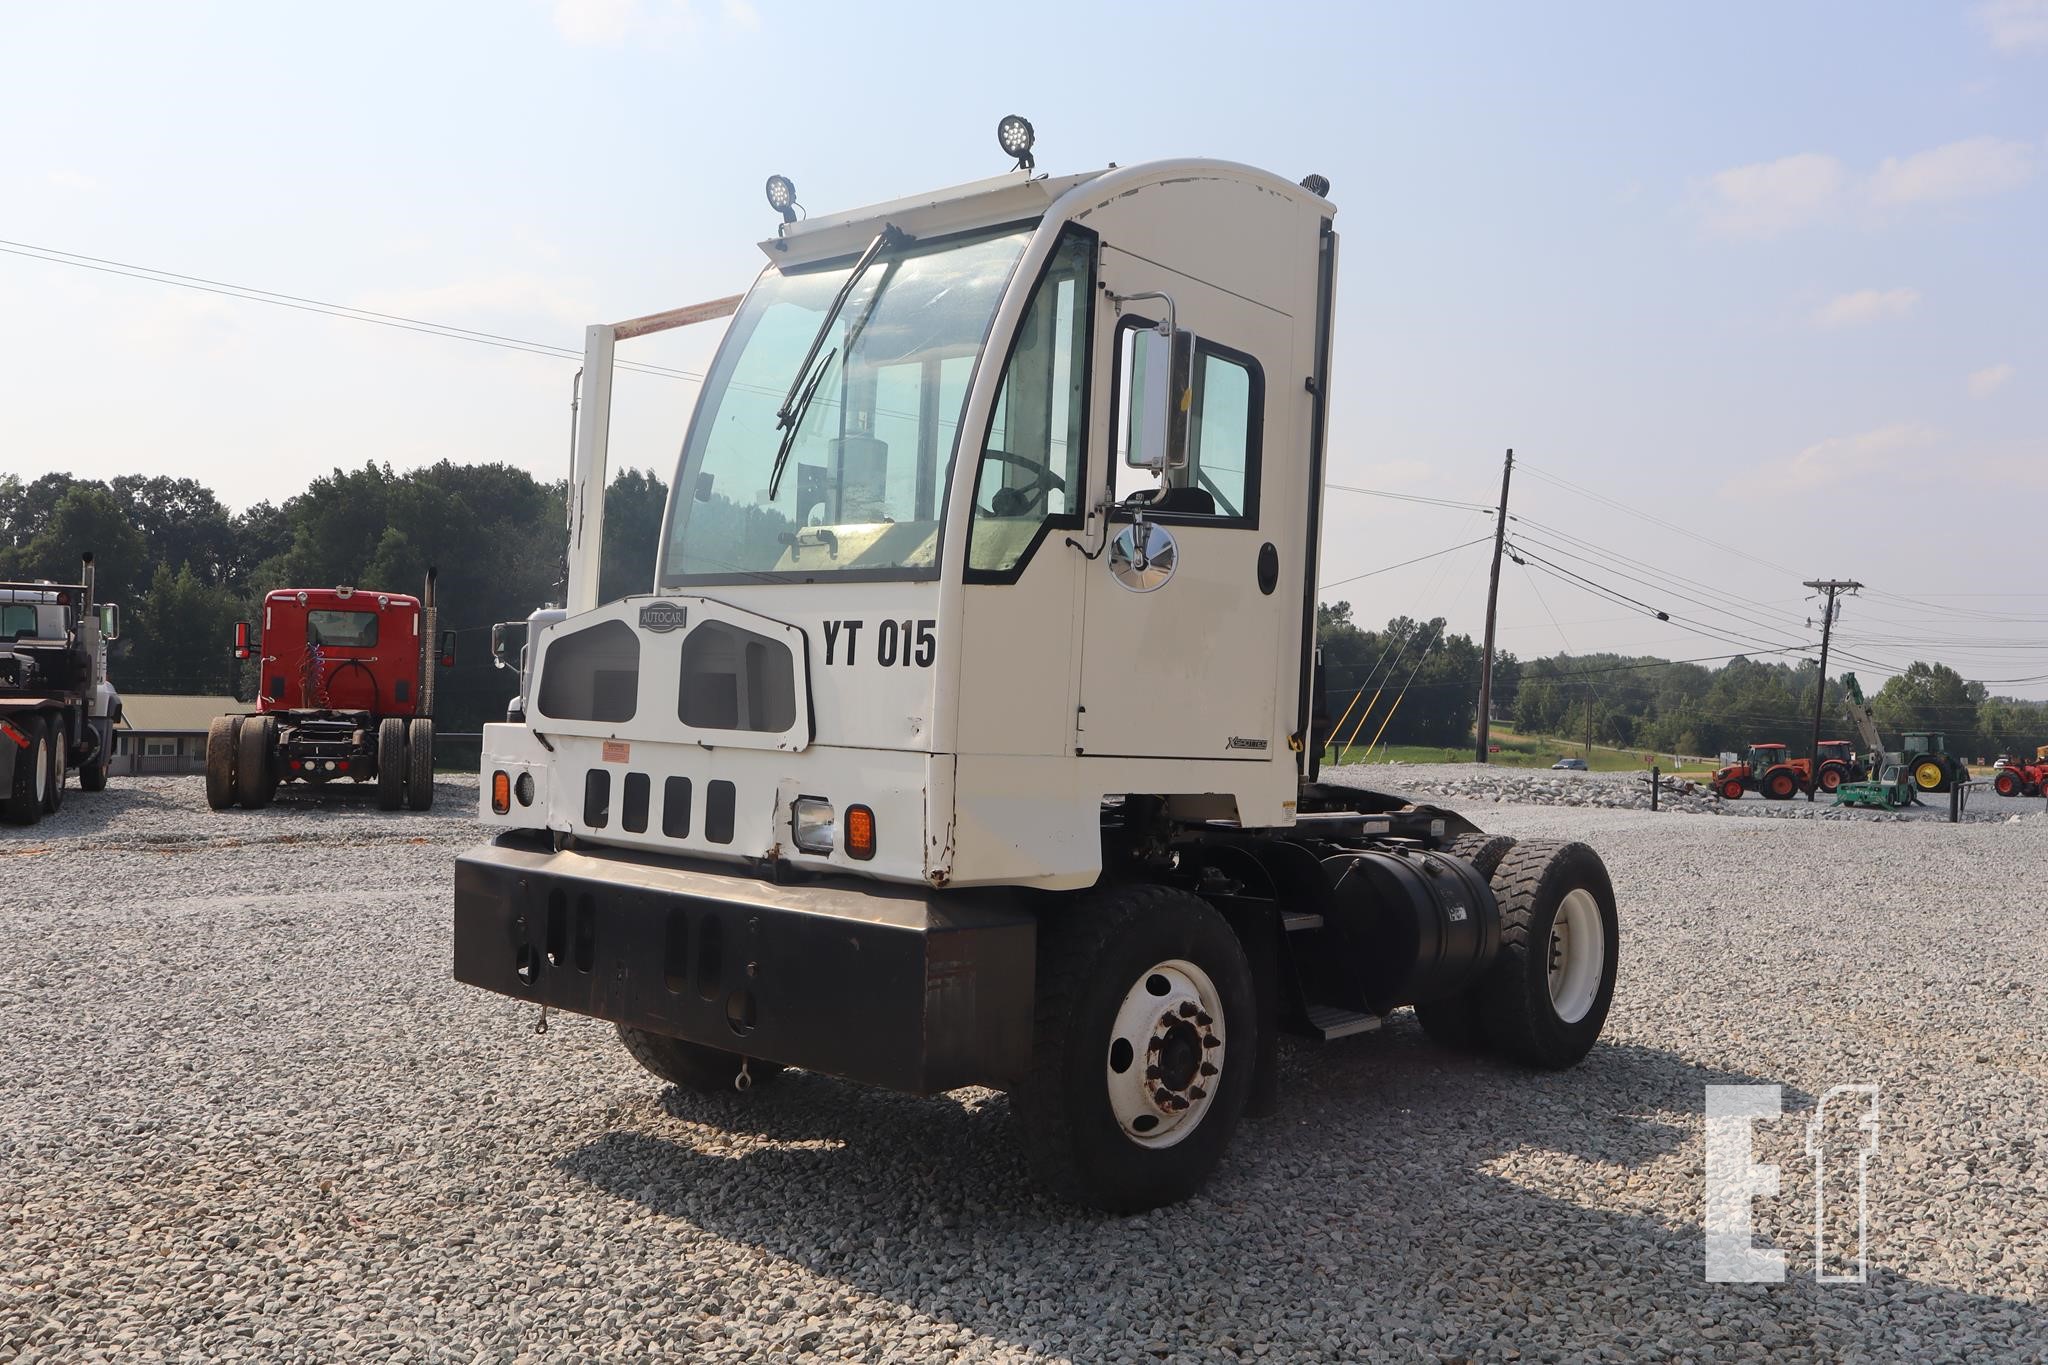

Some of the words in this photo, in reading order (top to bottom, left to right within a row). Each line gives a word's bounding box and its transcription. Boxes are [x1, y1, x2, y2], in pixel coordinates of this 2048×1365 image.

[641, 610, 682, 624] AUTOCAR
[823, 620, 864, 666] YT
[878, 619, 936, 668] 015
